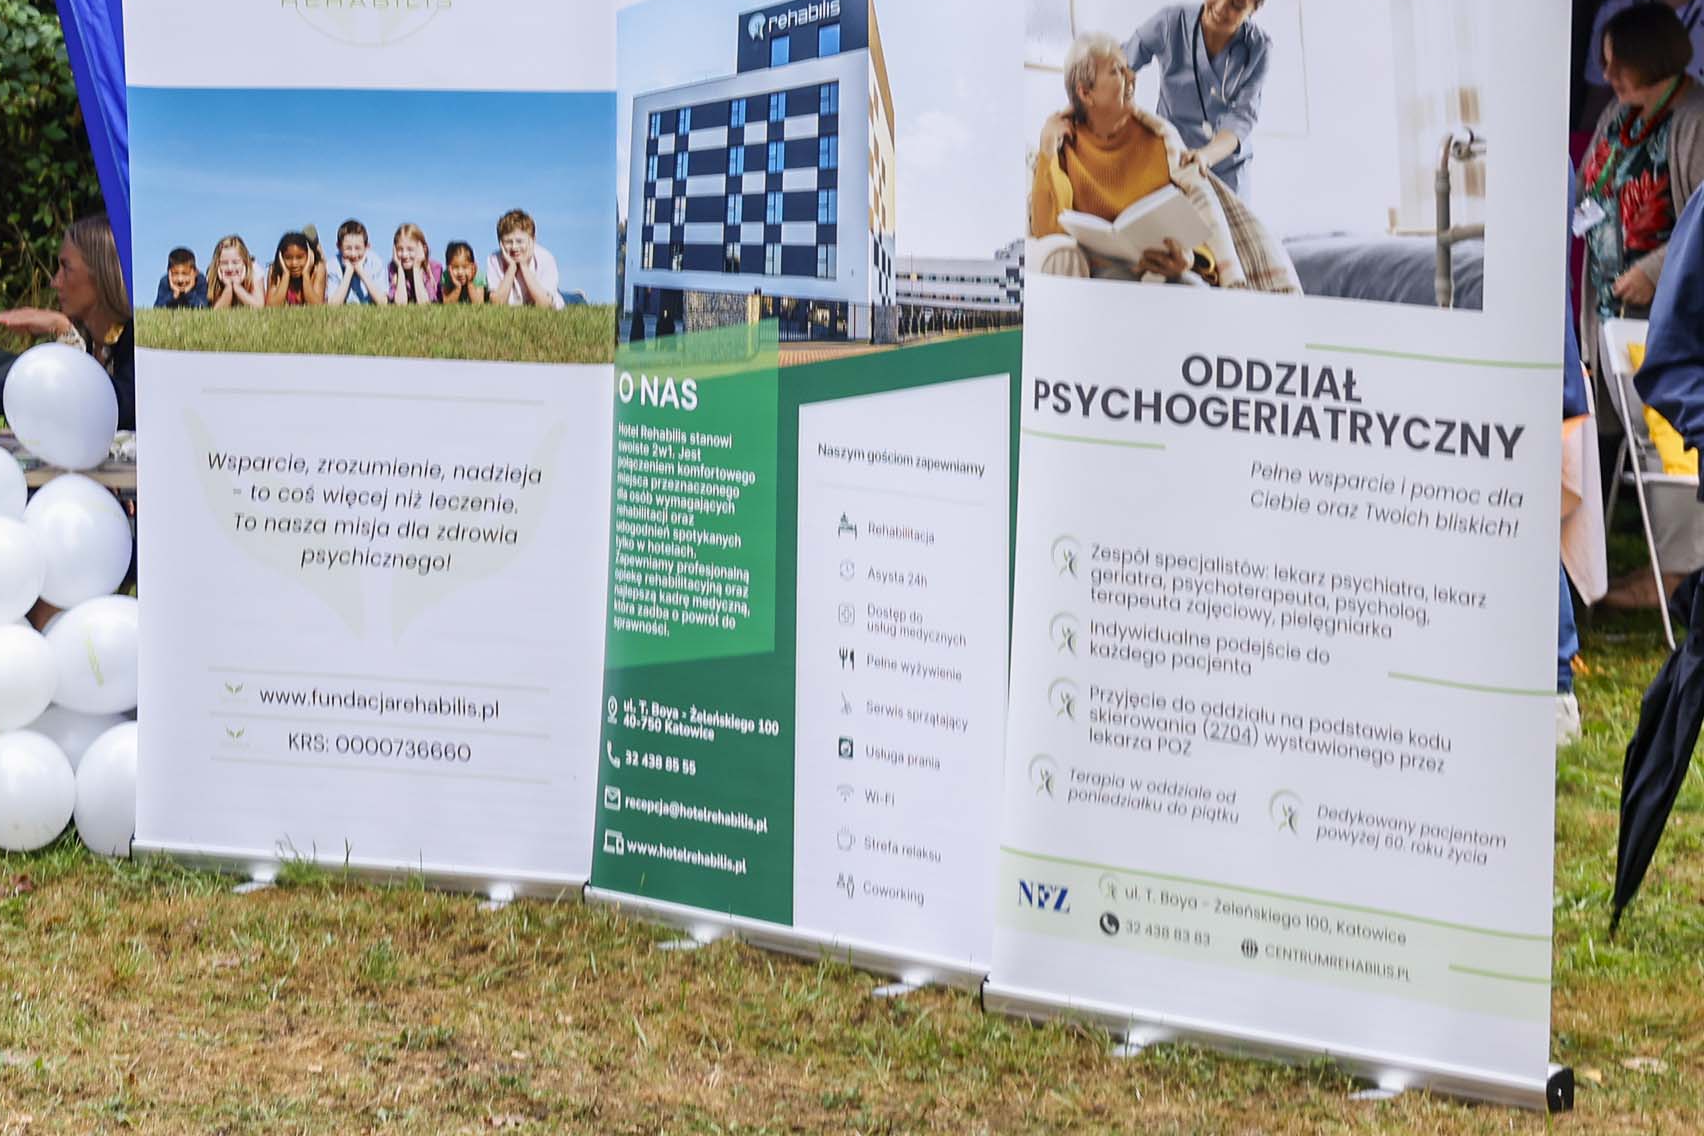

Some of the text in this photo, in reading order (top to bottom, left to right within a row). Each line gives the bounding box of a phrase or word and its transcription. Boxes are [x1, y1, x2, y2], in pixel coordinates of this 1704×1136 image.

[617, 371, 697, 411] O NAS
[1181, 354, 1361, 403] ODDZIAŁ
[617, 421, 731, 448] Hotel Rehabilis stanowi
[1033, 378, 1525, 459] PSYCHOGERIATRYCZNY
[207, 451, 541, 489] Wsparcie, zrozumienie, nadzieja
[677, 462, 755, 485] komfortowego
[817, 443, 985, 477] Naszym gościom zapewniamy
[250, 484, 270, 501] to
[277, 485, 313, 503] coś
[322, 485, 387, 511] więcej
[394, 489, 421, 508] niż
[428, 490, 517, 513] leczenie.
[1249, 461, 1301, 483] Pełne
[1307, 470, 1394, 491] wsparcie
[1410, 481, 1479, 504] pomoc
[1487, 487, 1523, 508] dla
[234, 512, 517, 543] To nasza misja dla zdrowia
[1249, 489, 1518, 537] Ciebie oraz Twoich bliskich!
[867, 521, 934, 544] Rehabilitacja
[299, 546, 451, 575] psychicznego!
[867, 567, 927, 587] Asysta 24h
[1089, 544, 1148, 566] Zespół
[1273, 563, 1324, 584] lekarz
[1329, 573, 1427, 601] psychiatra,
[1432, 584, 1486, 607] lekarz
[1089, 566, 1165, 590] geriatra,
[1171, 573, 1329, 609] psychoterapeuta,
[1089, 587, 1391, 637] terapeuta zajęciowy, pielęgniarka
[1089, 619, 1329, 663] Indywidualne podejście do
[1089, 640, 1251, 675] każdego pacjenta
[258, 686, 499, 720] www.fundacjarehabilis.pl
[1089, 684, 1450, 751] Przyjęcie do oddziału na podstawie kodu
[287, 732, 471, 762] KRS: 0000736660
[664, 720, 714, 741] Katowice
[1089, 707, 1444, 773] skierowania (2704) wystawionego przez
[1089, 728, 1190, 755] lekarza POZ
[864, 789, 894, 805] Wi-Fi
[1068, 768, 1235, 803] Terapia w oddziale od
[1066, 787, 1238, 823] poniedziałku do piątku
[1317, 803, 1505, 847] Dedykowany pacjentom
[625, 839, 746, 874] www.hotelrehabilis.pl
[1315, 825, 1379, 850] powyżej
[1410, 840, 1442, 857] roku
[1446, 847, 1486, 864] życia
[862, 881, 924, 907] Coworking
[1018, 879, 1070, 913] NFZ
[1124, 886, 1139, 899] ul.
[1213, 896, 1300, 928] Żeleńskiego
[1335, 919, 1405, 944] Katowice
[1264, 944, 1409, 981] CENTRUMREHABILIS.PL
